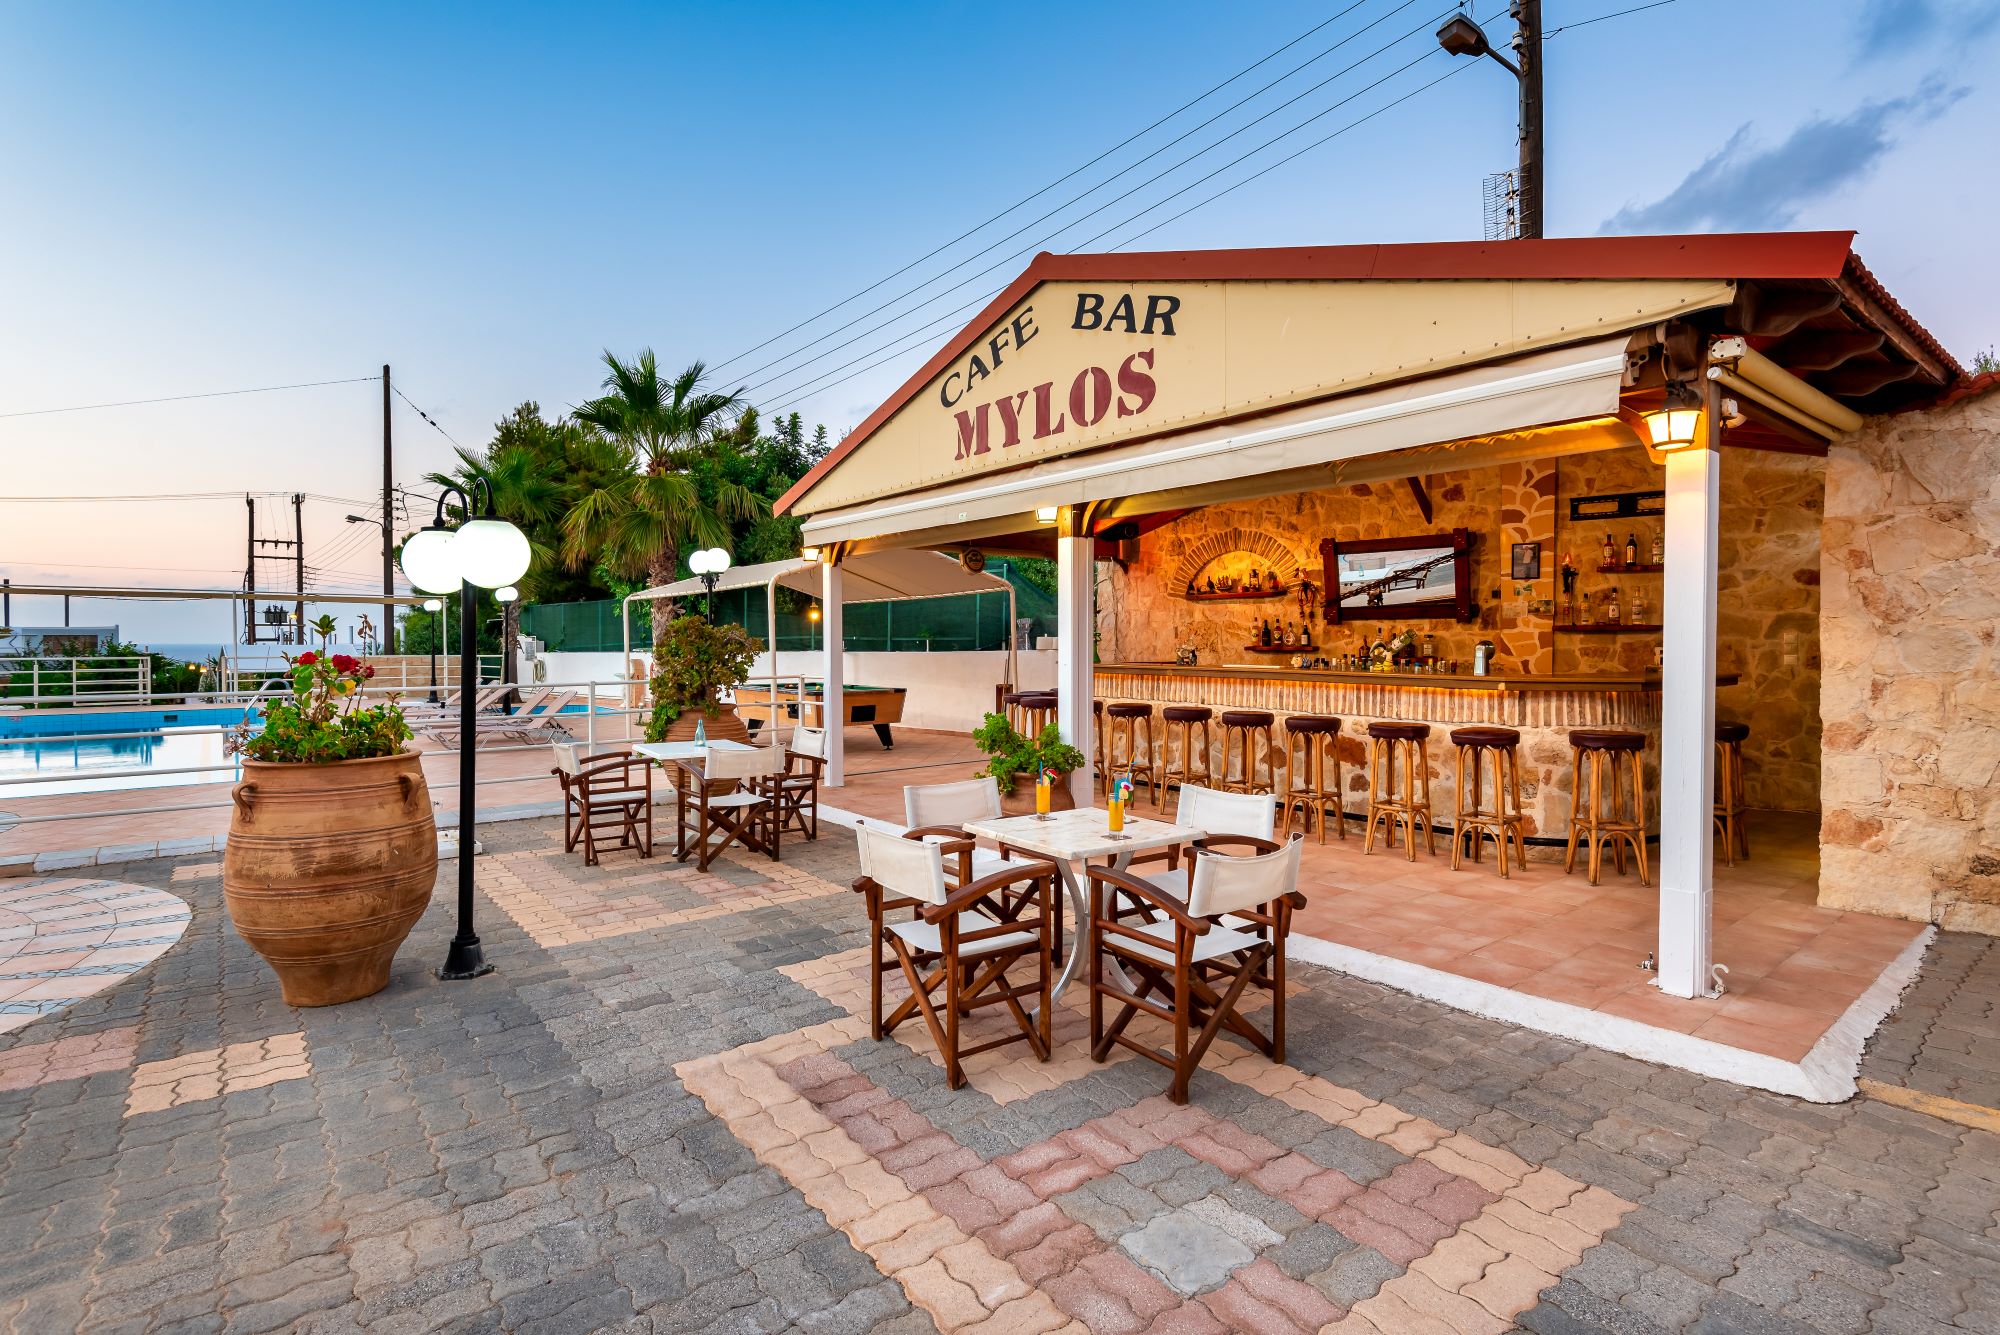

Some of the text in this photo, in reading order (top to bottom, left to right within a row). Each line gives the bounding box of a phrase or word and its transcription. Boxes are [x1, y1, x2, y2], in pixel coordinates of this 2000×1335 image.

[940, 293, 1181, 408] CAFE BAR
[954, 348, 1157, 461] MYLOS
